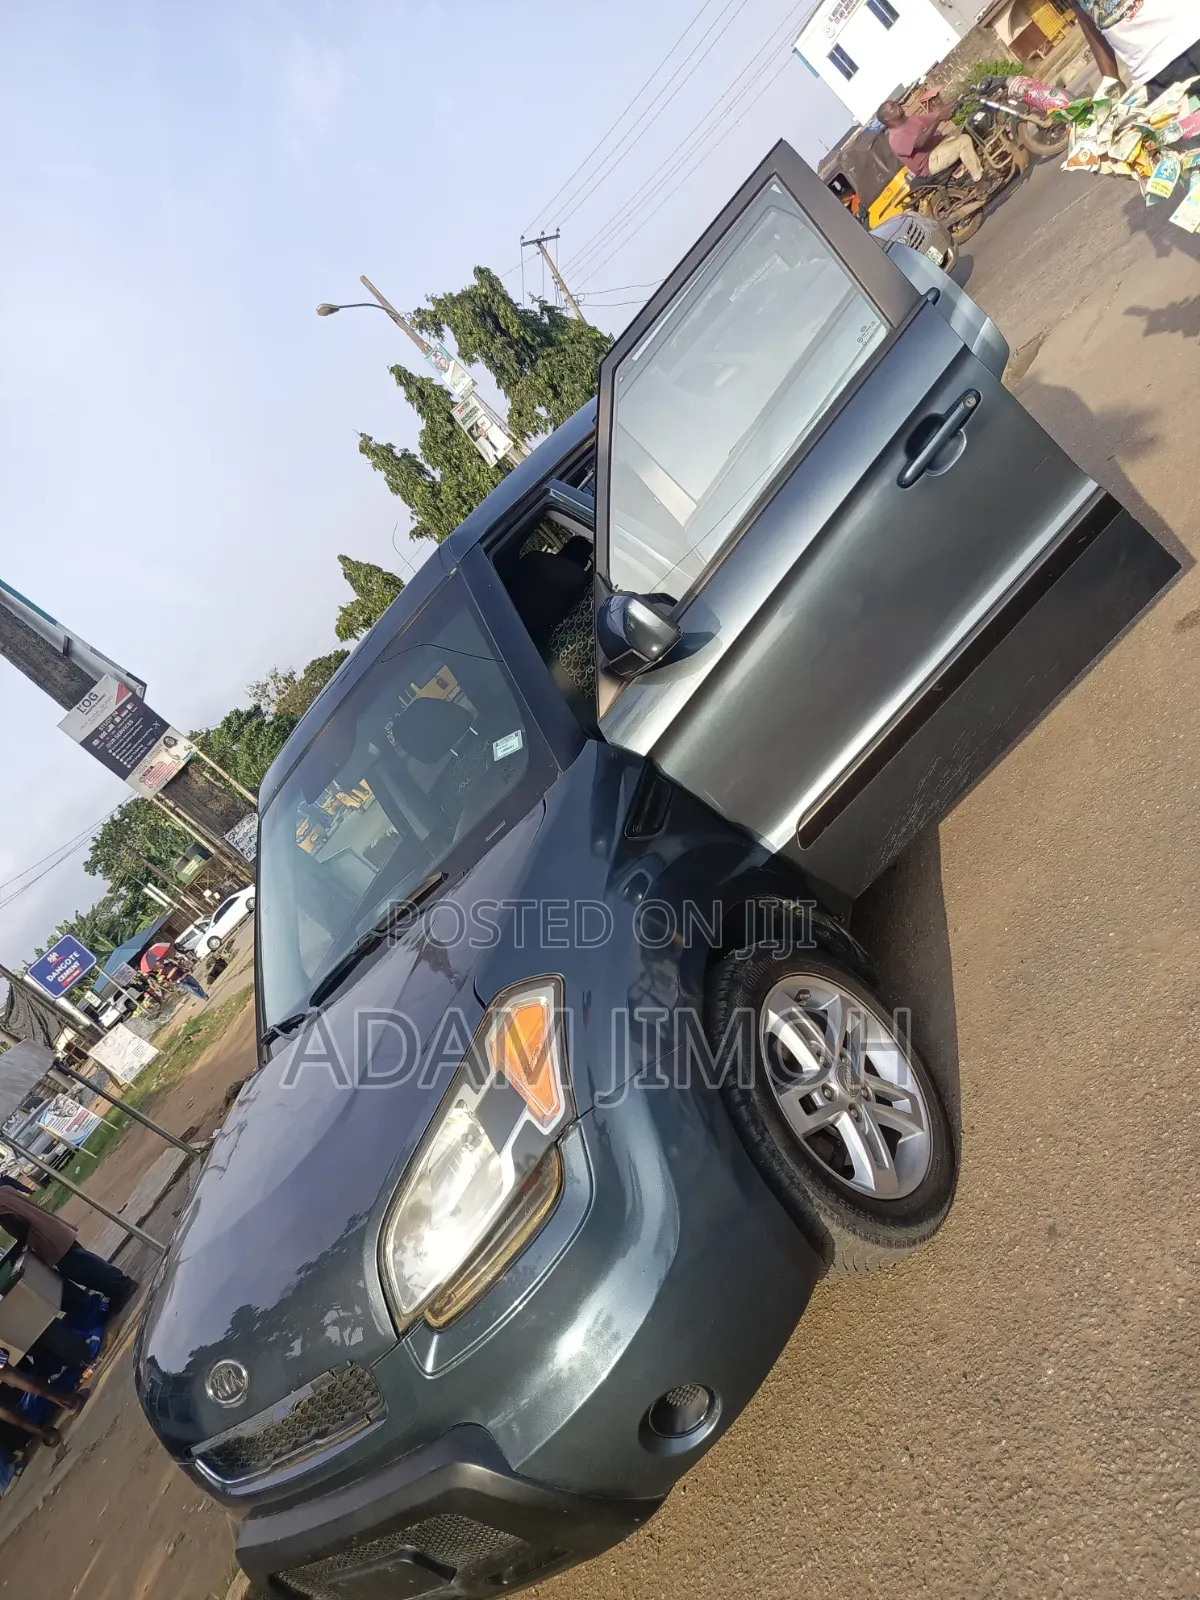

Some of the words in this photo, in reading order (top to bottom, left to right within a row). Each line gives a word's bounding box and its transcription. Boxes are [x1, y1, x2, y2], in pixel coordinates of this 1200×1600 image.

[76, 692, 98, 713] LOG
[98, 716, 113, 731] STUDY
[114, 718, 133, 739] SERVICES
[46, 951, 80, 982] DANGOTE
[57, 961, 80, 982] CEMENT
[212, 1368, 244, 1399] KIA
